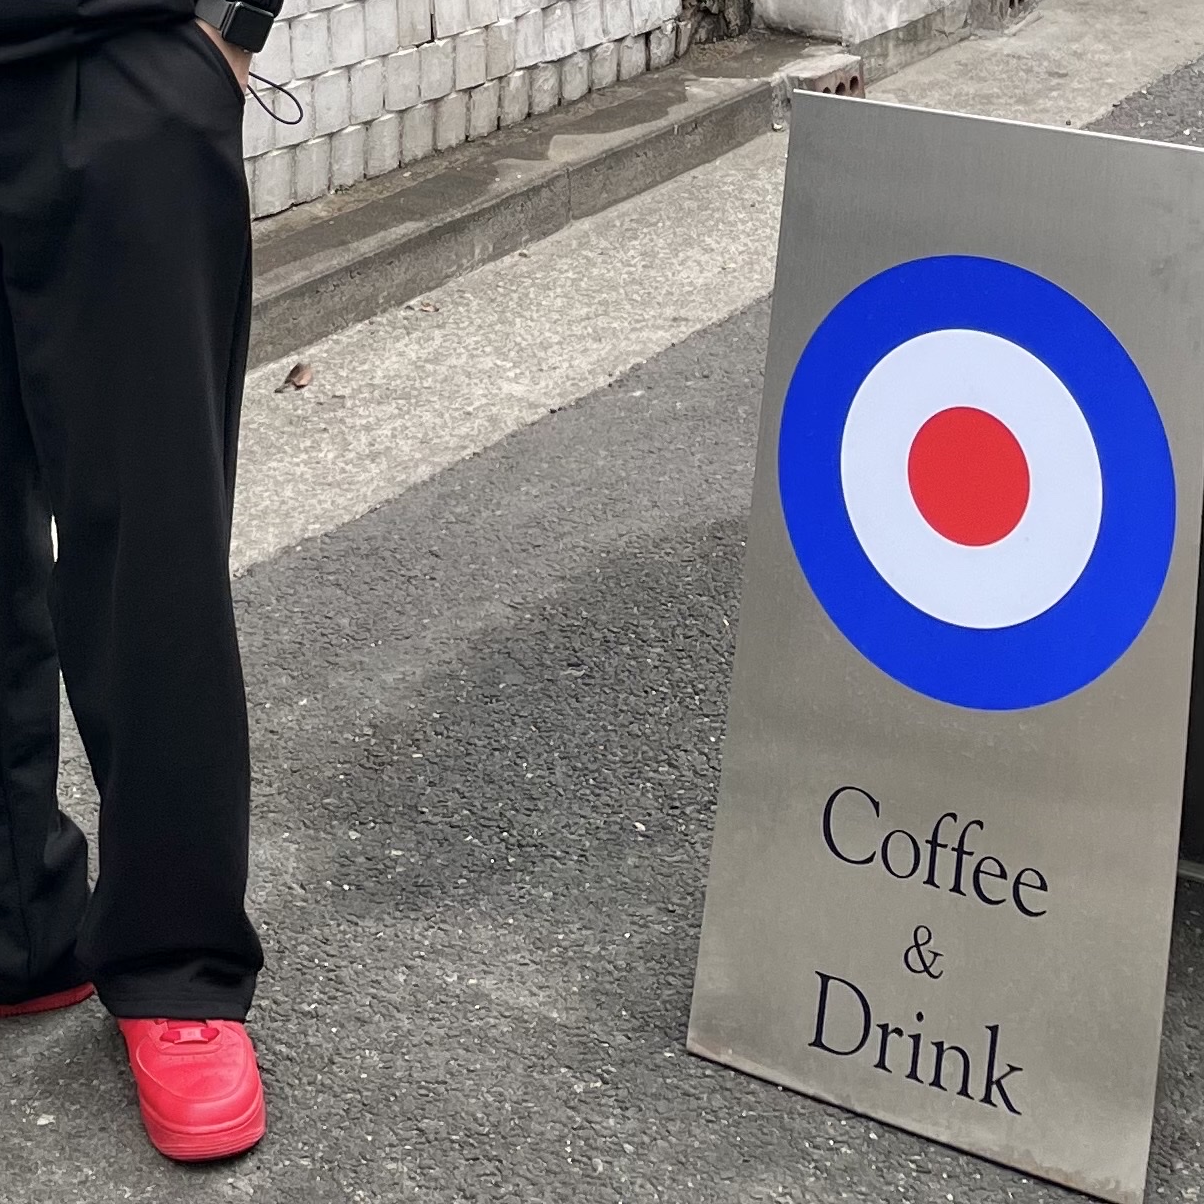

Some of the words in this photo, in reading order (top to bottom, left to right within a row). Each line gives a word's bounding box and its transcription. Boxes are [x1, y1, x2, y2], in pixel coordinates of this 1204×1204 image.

[822, 785, 1049, 918] Coffee
[903, 924, 944, 980] &
[807, 970, 1024, 1116] Drink
